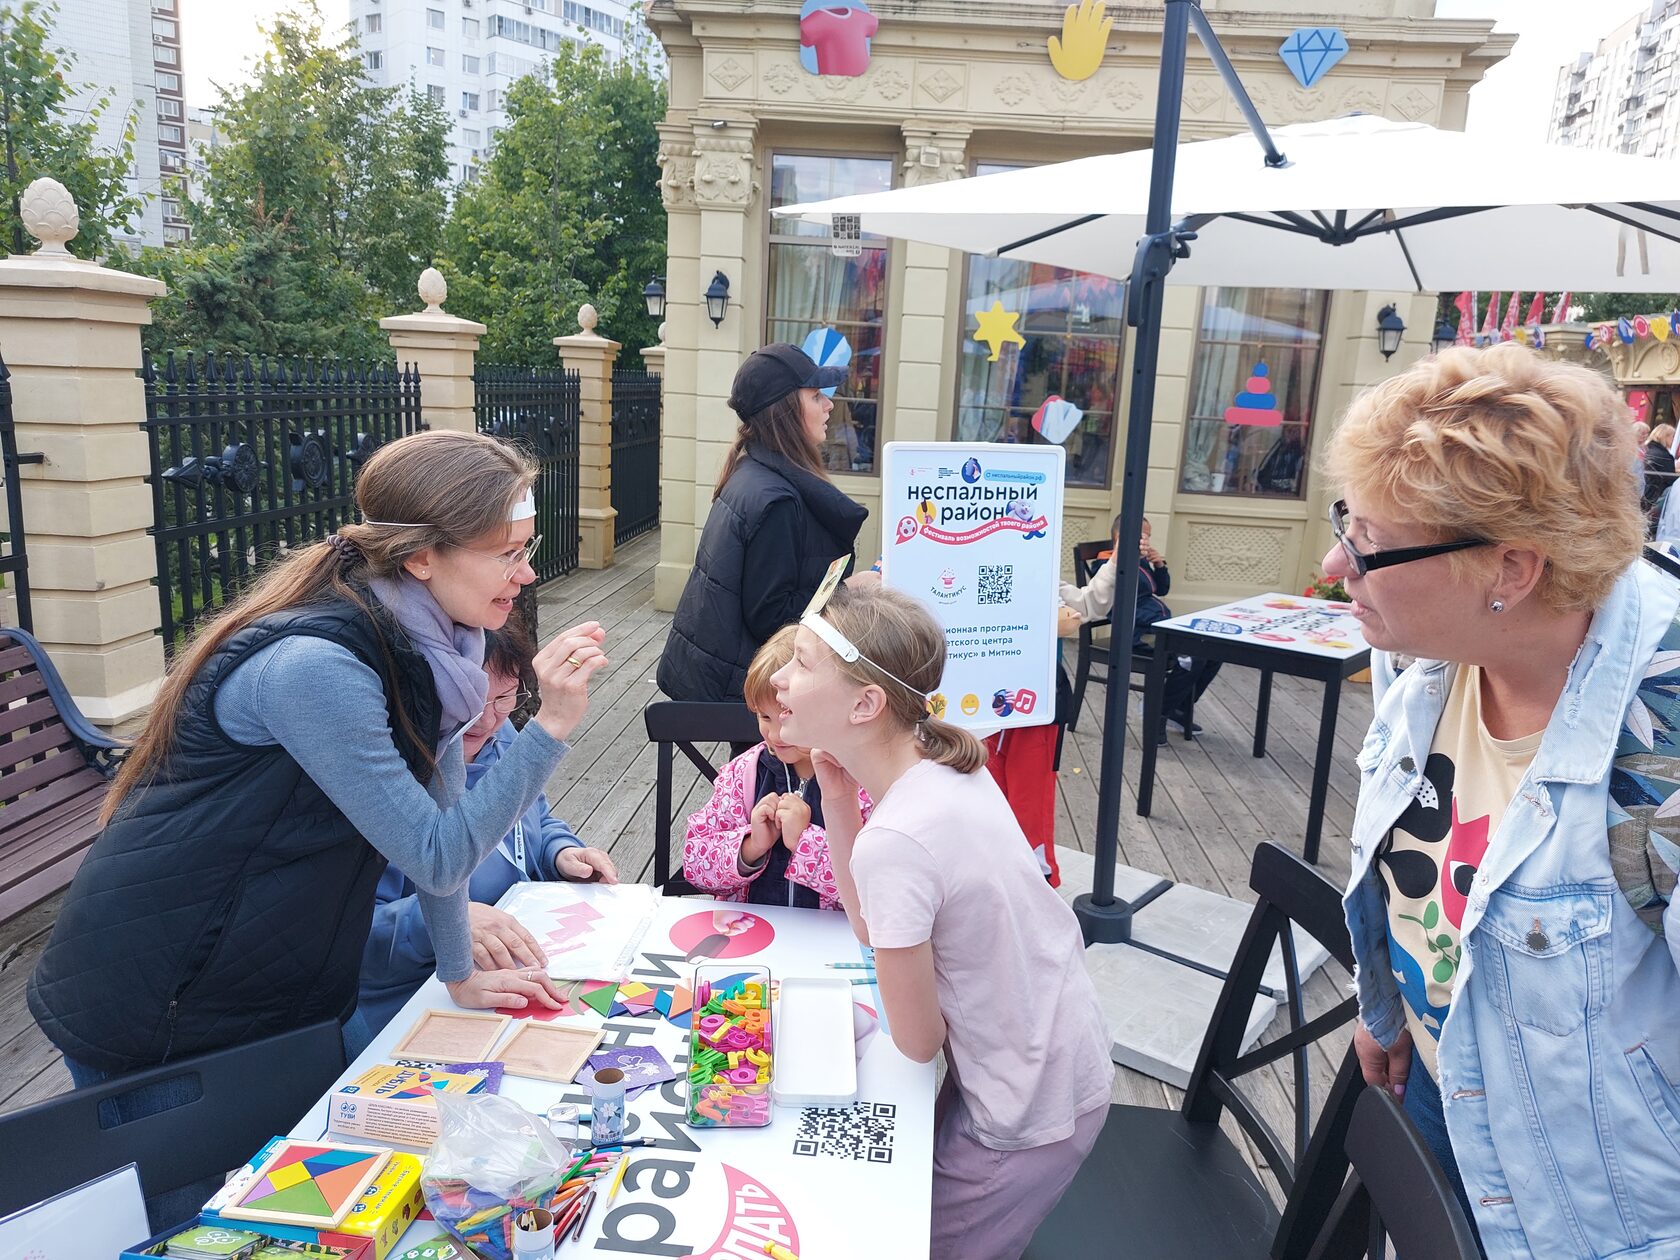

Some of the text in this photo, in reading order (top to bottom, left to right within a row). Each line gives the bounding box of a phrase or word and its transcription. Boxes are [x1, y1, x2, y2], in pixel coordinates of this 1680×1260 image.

[907, 483, 1038, 500] неспальный
[941, 502, 1004, 525] район
[923, 520, 1044, 542] фестиваль возможностей твоего района
[930, 585, 967, 598] ТАЛАНТИКУС
[945, 624, 1029, 634] ионная программа
[946, 637, 1013, 647] етского центра
[948, 651, 979, 661] тикус»
[988, 648, 1022, 657] Митино
[340, 1112, 356, 1120] ТУВИ
[709, 1183, 792, 1260] ПАТЬ
